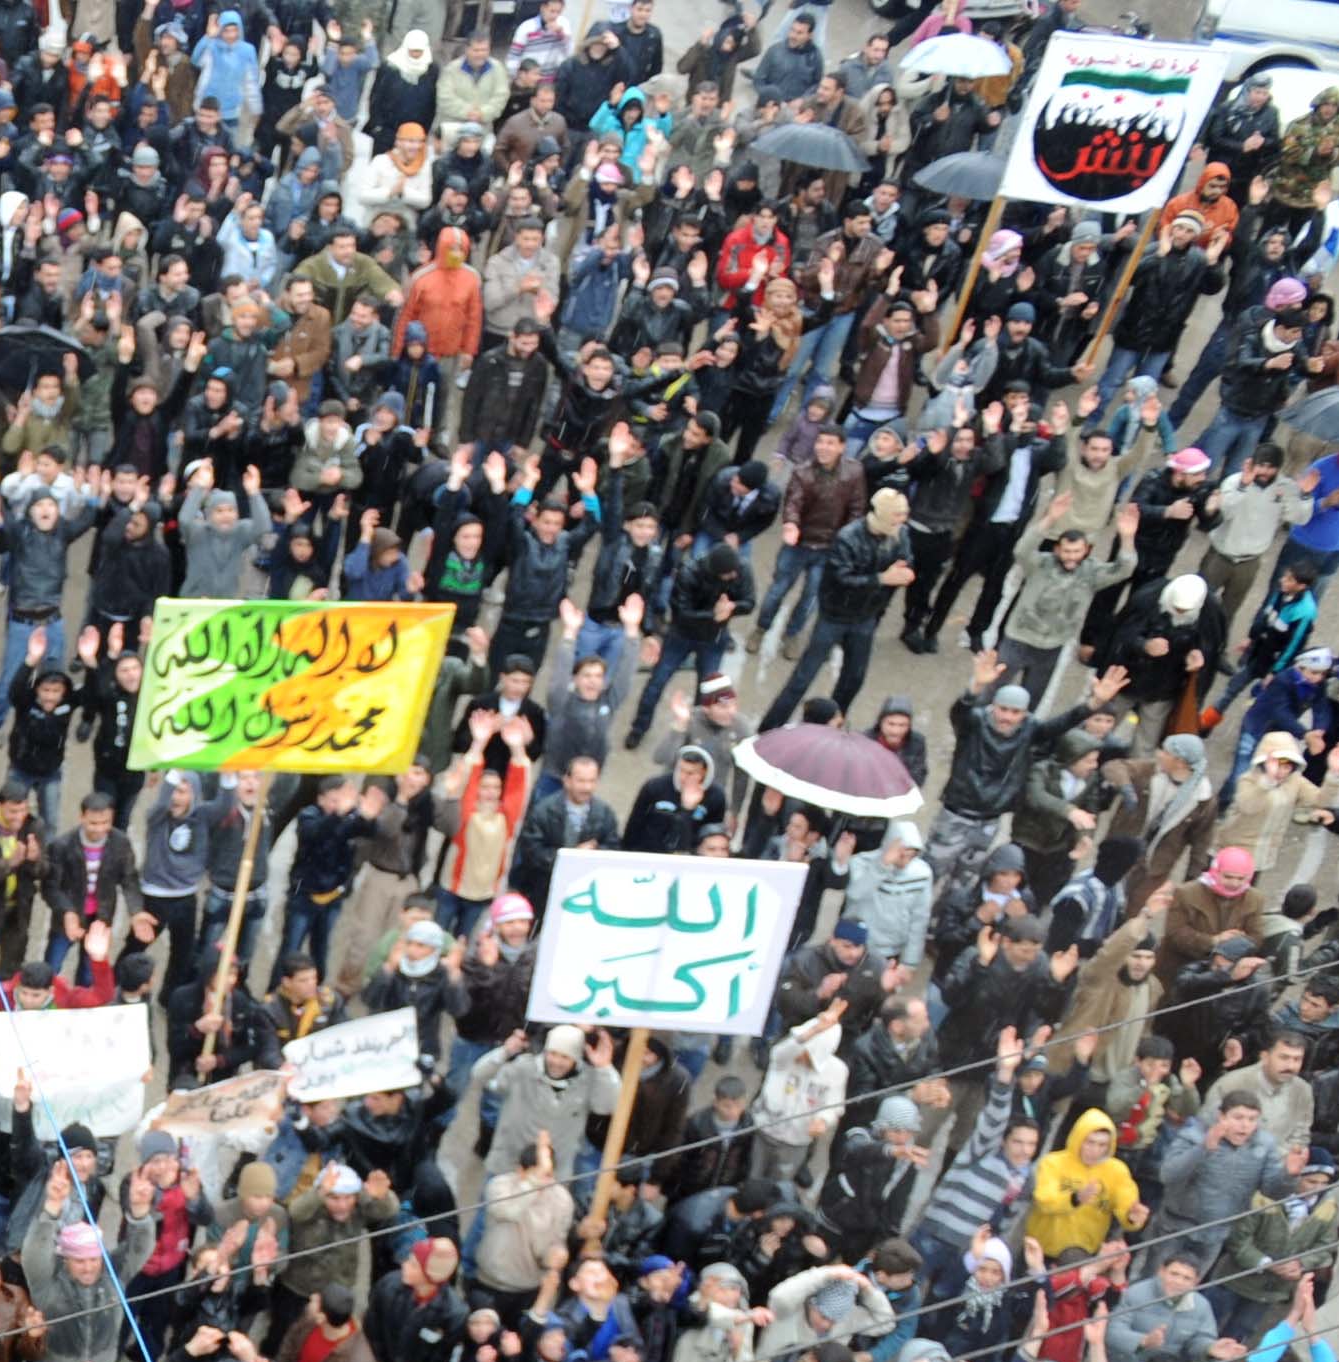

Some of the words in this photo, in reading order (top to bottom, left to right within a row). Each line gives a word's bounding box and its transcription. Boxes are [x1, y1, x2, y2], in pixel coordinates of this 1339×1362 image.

[1038, 128, 1169, 187] بنش
[153, 612, 230, 677] الله
[356, 621, 398, 673] لا
[149, 687, 237, 743] الله
[243, 694, 326, 749] رسول
[306, 707, 386, 751] محمد
